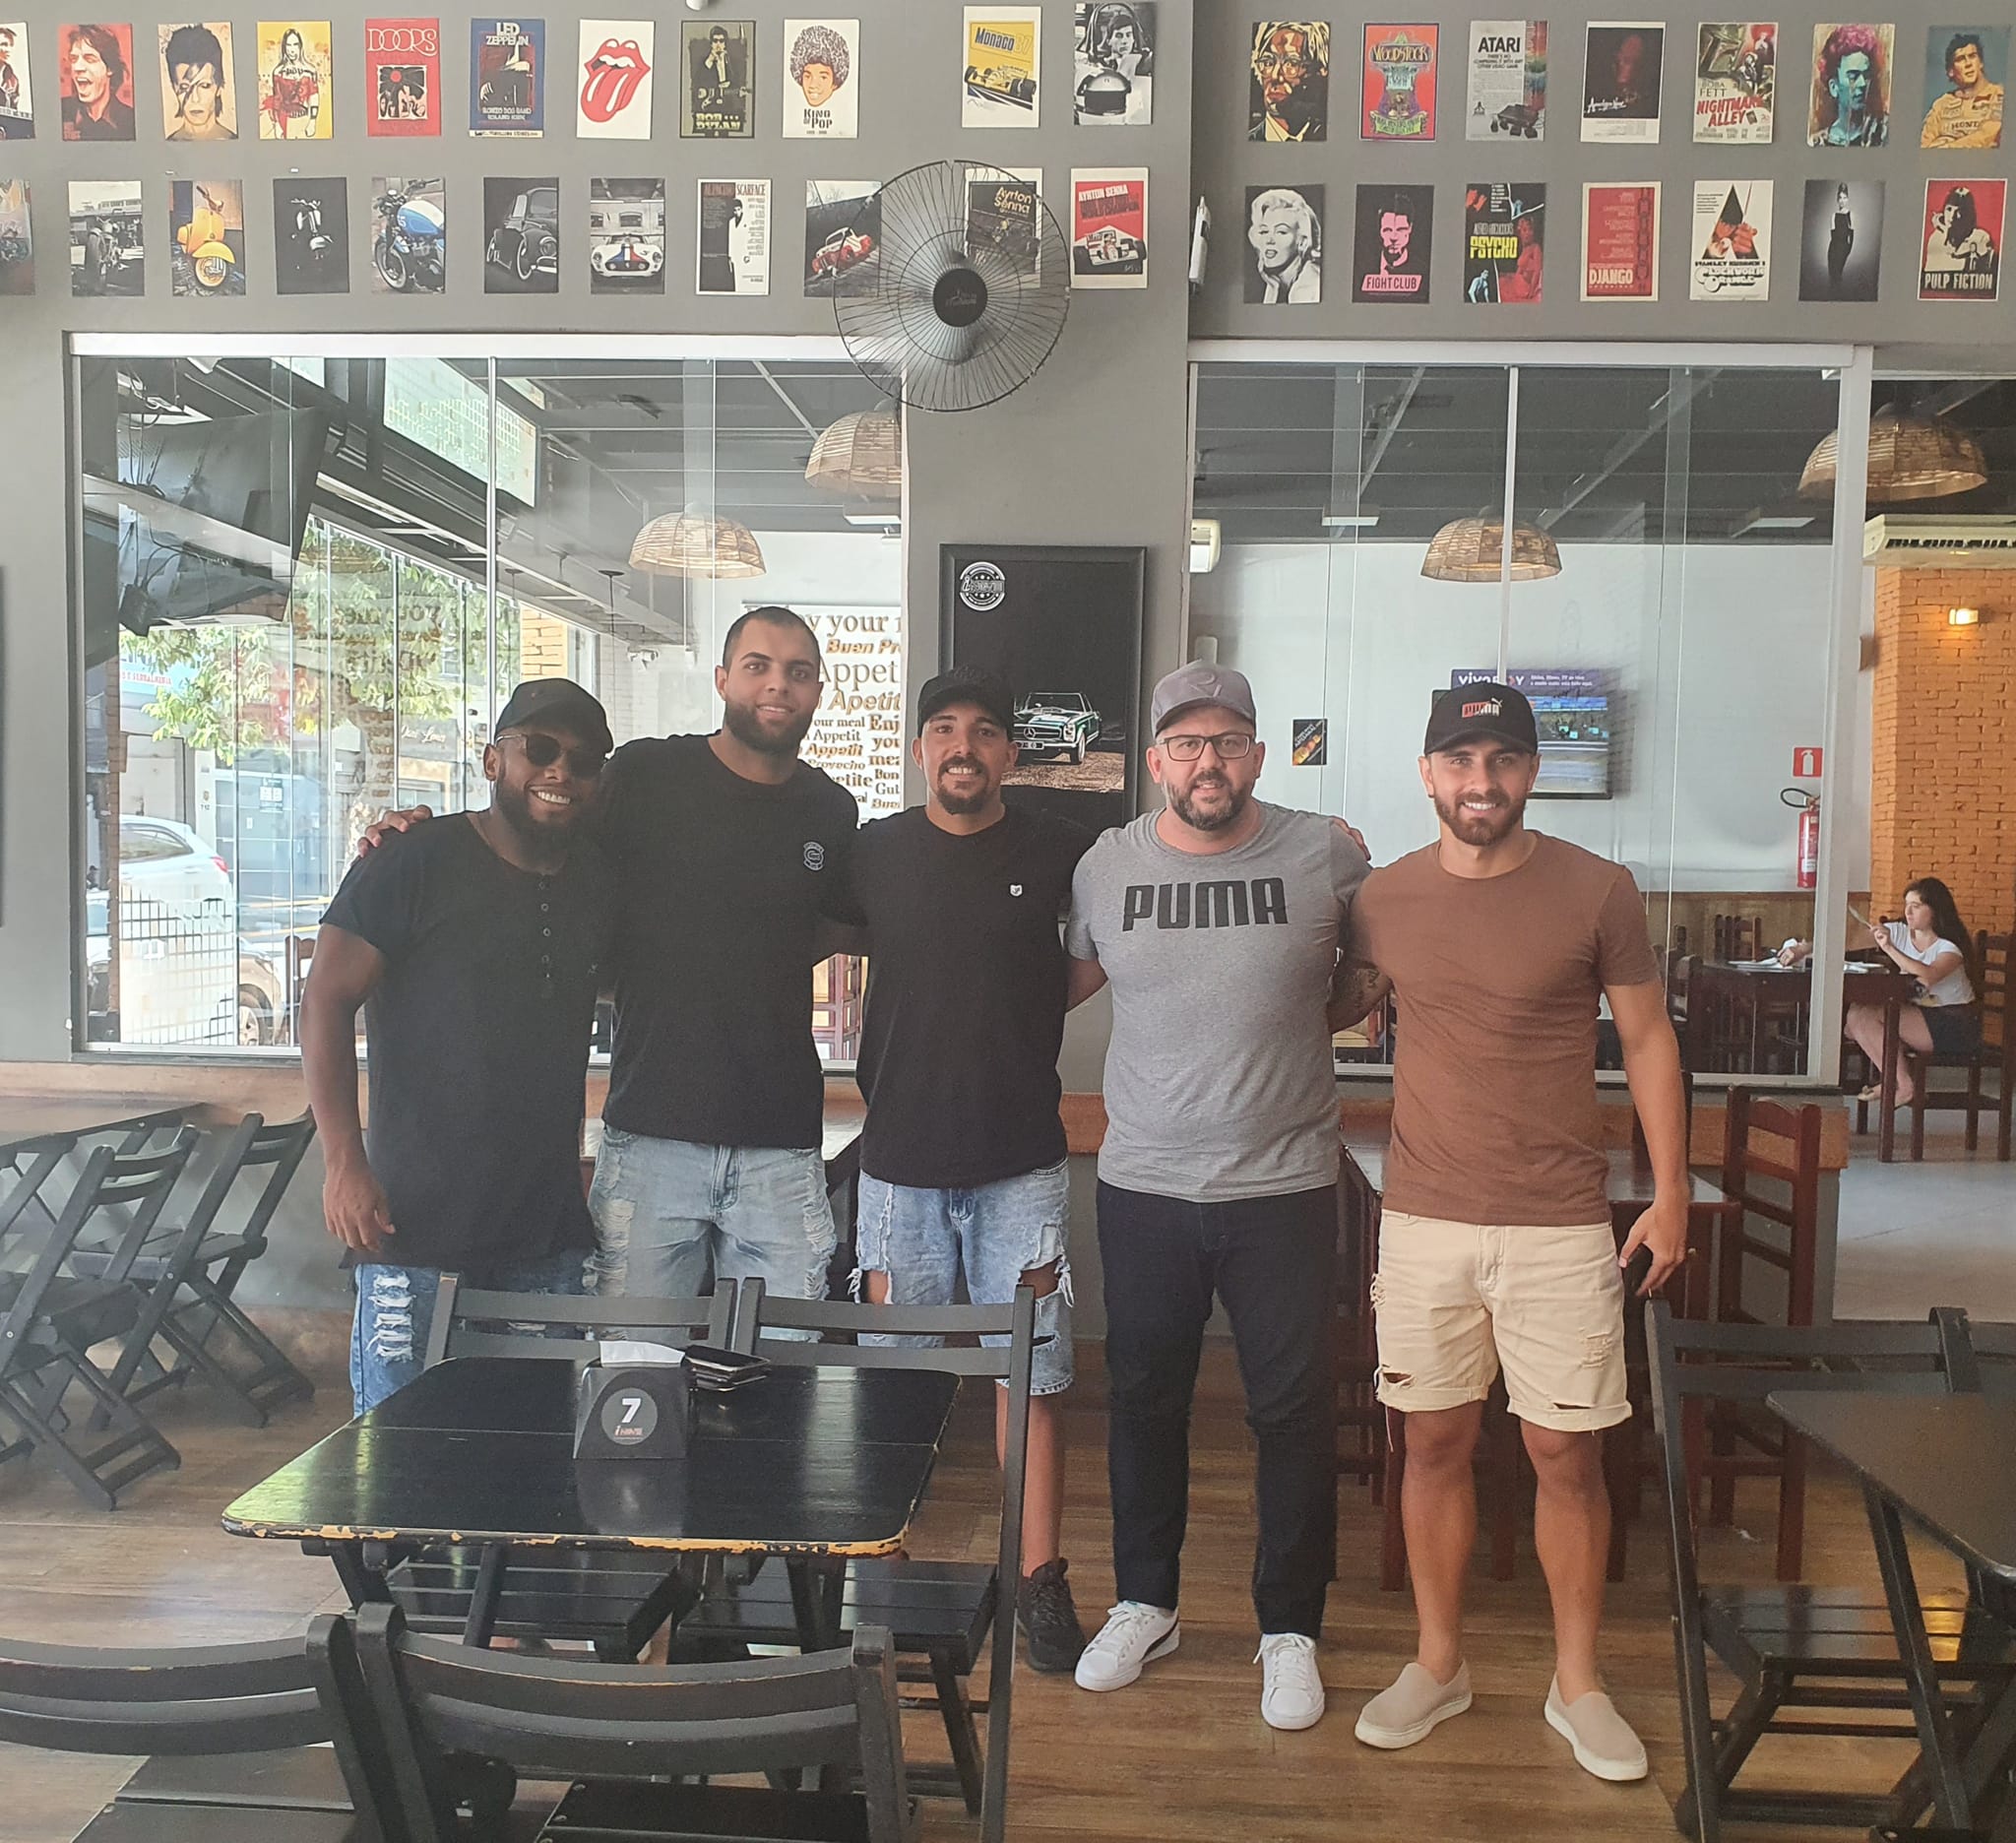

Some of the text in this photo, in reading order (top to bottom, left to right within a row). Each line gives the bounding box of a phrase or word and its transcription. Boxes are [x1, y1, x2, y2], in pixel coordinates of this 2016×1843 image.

[496, 22, 520, 36] LED
[367, 28, 437, 56] DOORS
[1478, 36, 1521, 52] ATARI
[1700, 88, 1728, 97] FETT
[803, 108, 831, 119] KING
[1708, 109, 1746, 128] ALLEY
[811, 118, 833, 129] POP
[996, 186, 1033, 205] Ayrton
[994, 196, 1031, 214] Senna
[1470, 236, 1518, 259] PSYCHO
[1366, 277, 1417, 289] FIGHT CLUB
[1589, 269, 1633, 285] DJANGO
[1924, 273, 1993, 289] PULP FICTION
[826, 614, 889, 637] your
[826, 638, 874, 654] Buen
[1462, 701, 1500, 718] PUMA
[838, 714, 865, 727] meal
[813, 729, 861, 743] Appetit
[874, 768, 900, 780] Bon
[1122, 877, 1289, 931] PUMA
[622, 1398, 641, 1423] 7
